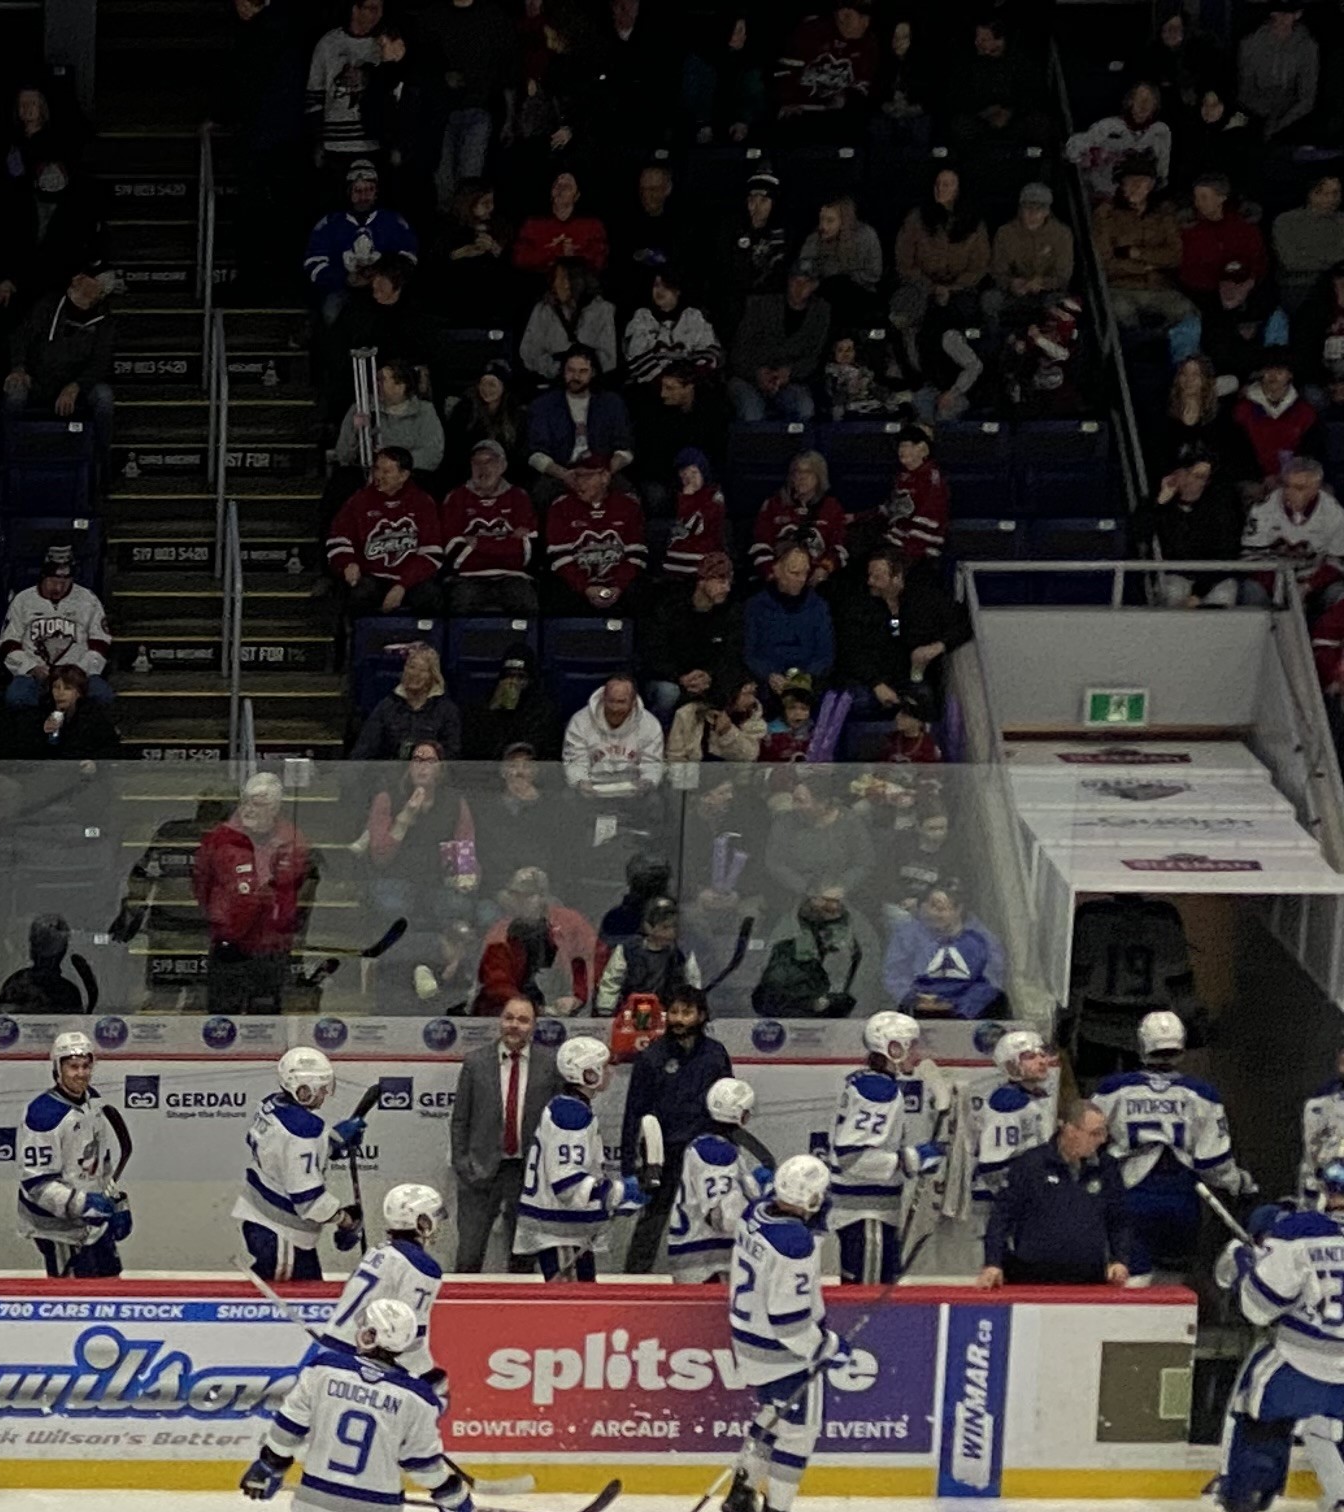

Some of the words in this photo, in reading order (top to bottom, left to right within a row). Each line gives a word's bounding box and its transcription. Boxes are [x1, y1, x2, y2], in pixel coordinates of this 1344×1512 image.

[31, 617, 76, 641] STORM
[165, 1092, 247, 1108] GERDAU
[166, 1110, 196, 1120] Shape
[197, 1110, 215, 1119] the
[216, 1110, 247, 1119] future
[854, 1111, 888, 1135] 22
[23, 1146, 53, 1168] 95
[558, 1144, 585, 1166] 93
[705, 1175, 732, 1200] 23
[795, 1273, 810, 1296] 2
[39, 1303, 91, 1319] CARS
[94, 1303, 117, 1319] IN
[118, 1303, 184, 1320] STOCK
[485, 1328, 879, 1406] splitsve
[327, 1378, 402, 1415] COUGHLAN
[962, 1318, 993, 1460] WINMAR.ca
[24, 1430, 145, 1446] Wilson's
[152, 1431, 248, 1447] Better
[452, 1420, 554, 1438] BOWLING
[590, 1420, 681, 1438] ARCADE
[826, 1420, 909, 1439] EVENTS
[327, 1408, 377, 1478] 9
